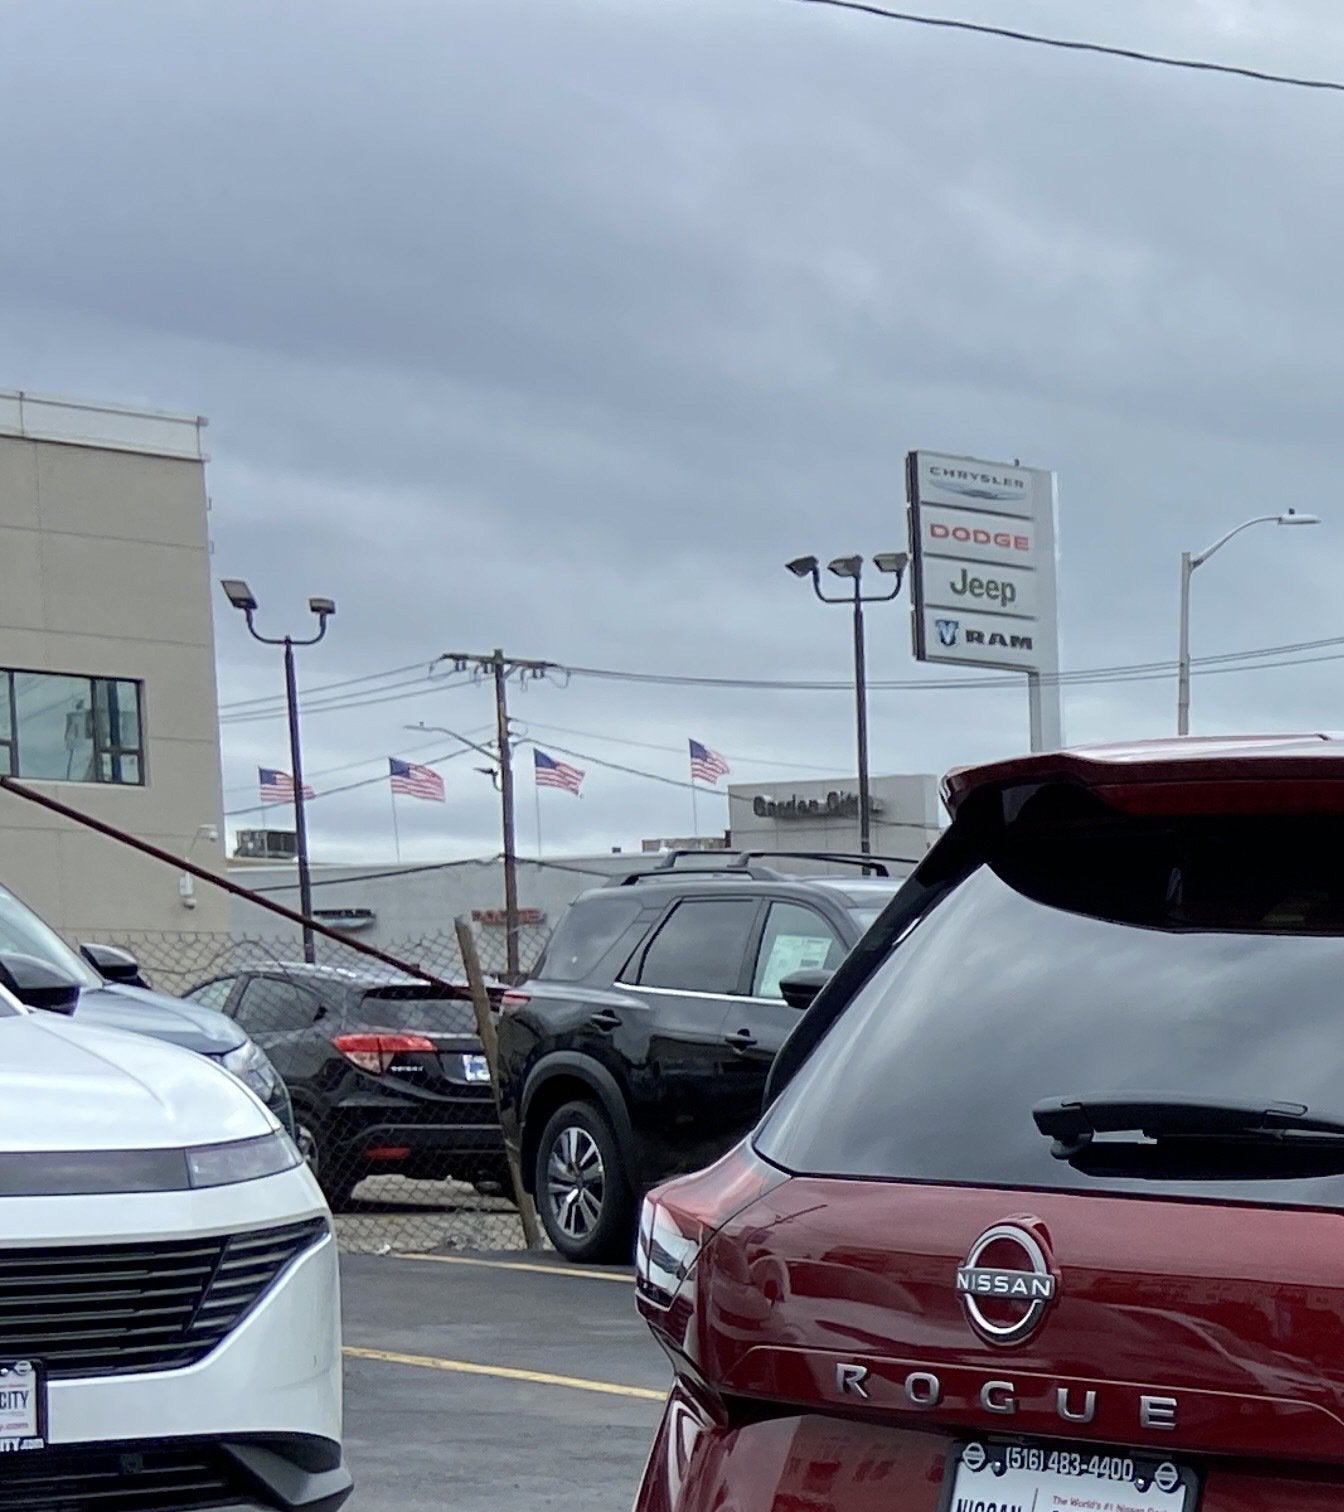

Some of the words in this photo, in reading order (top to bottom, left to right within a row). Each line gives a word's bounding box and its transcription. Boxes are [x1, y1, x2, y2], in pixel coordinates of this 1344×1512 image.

[929, 466, 1025, 489] CHRYSLER
[930, 523, 1030, 550] DODGE
[950, 568, 1017, 607] Jeep
[965, 629, 1034, 651] RAM
[957, 1273, 1052, 1297] NISSAN
[836, 1362, 1178, 1431] ROGUE
[1005, 1447, 1045, 1471] (516)
[1048, 1451, 1133, 1481] 483-4400
[1053, 1495, 1068, 1506] The
